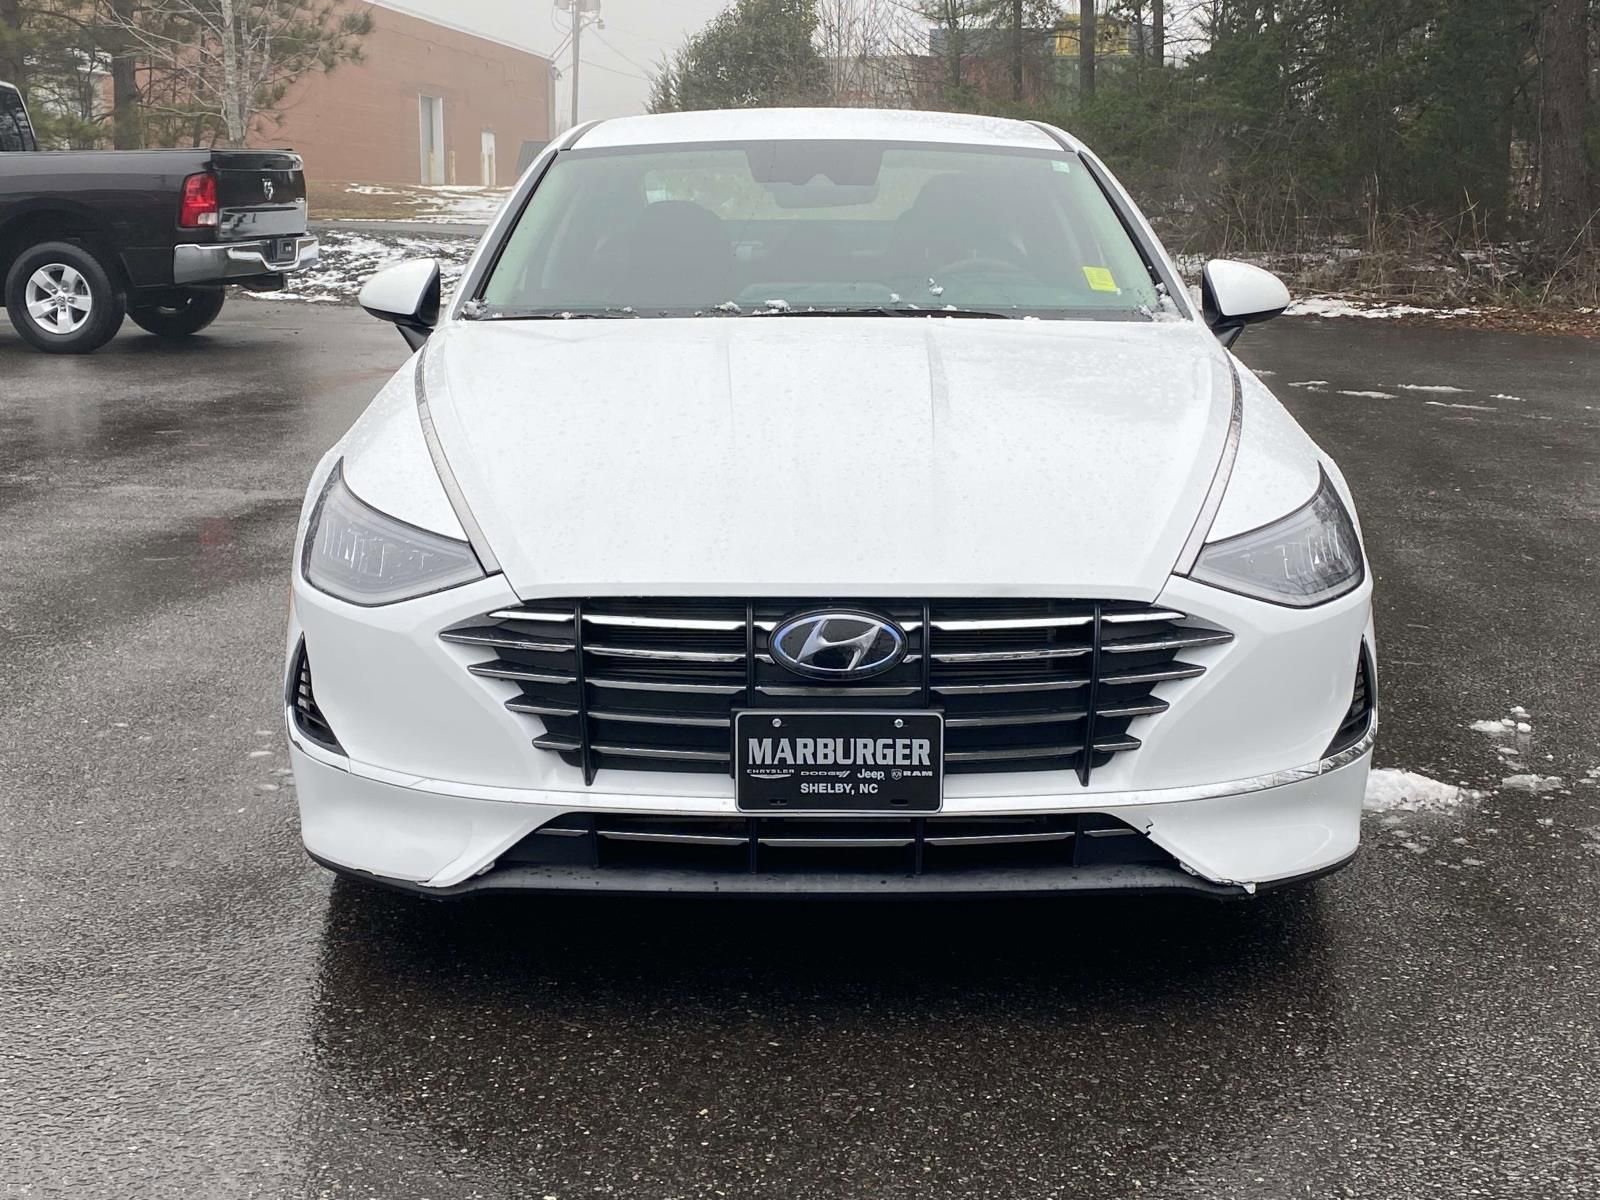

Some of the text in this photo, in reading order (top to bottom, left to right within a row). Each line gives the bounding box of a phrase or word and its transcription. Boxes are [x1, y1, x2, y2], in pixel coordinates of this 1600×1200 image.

[748, 738, 931, 766] MARBURGER
[857, 768, 884, 780] Jeep
[800, 783, 878, 795] SHELBY, NC
